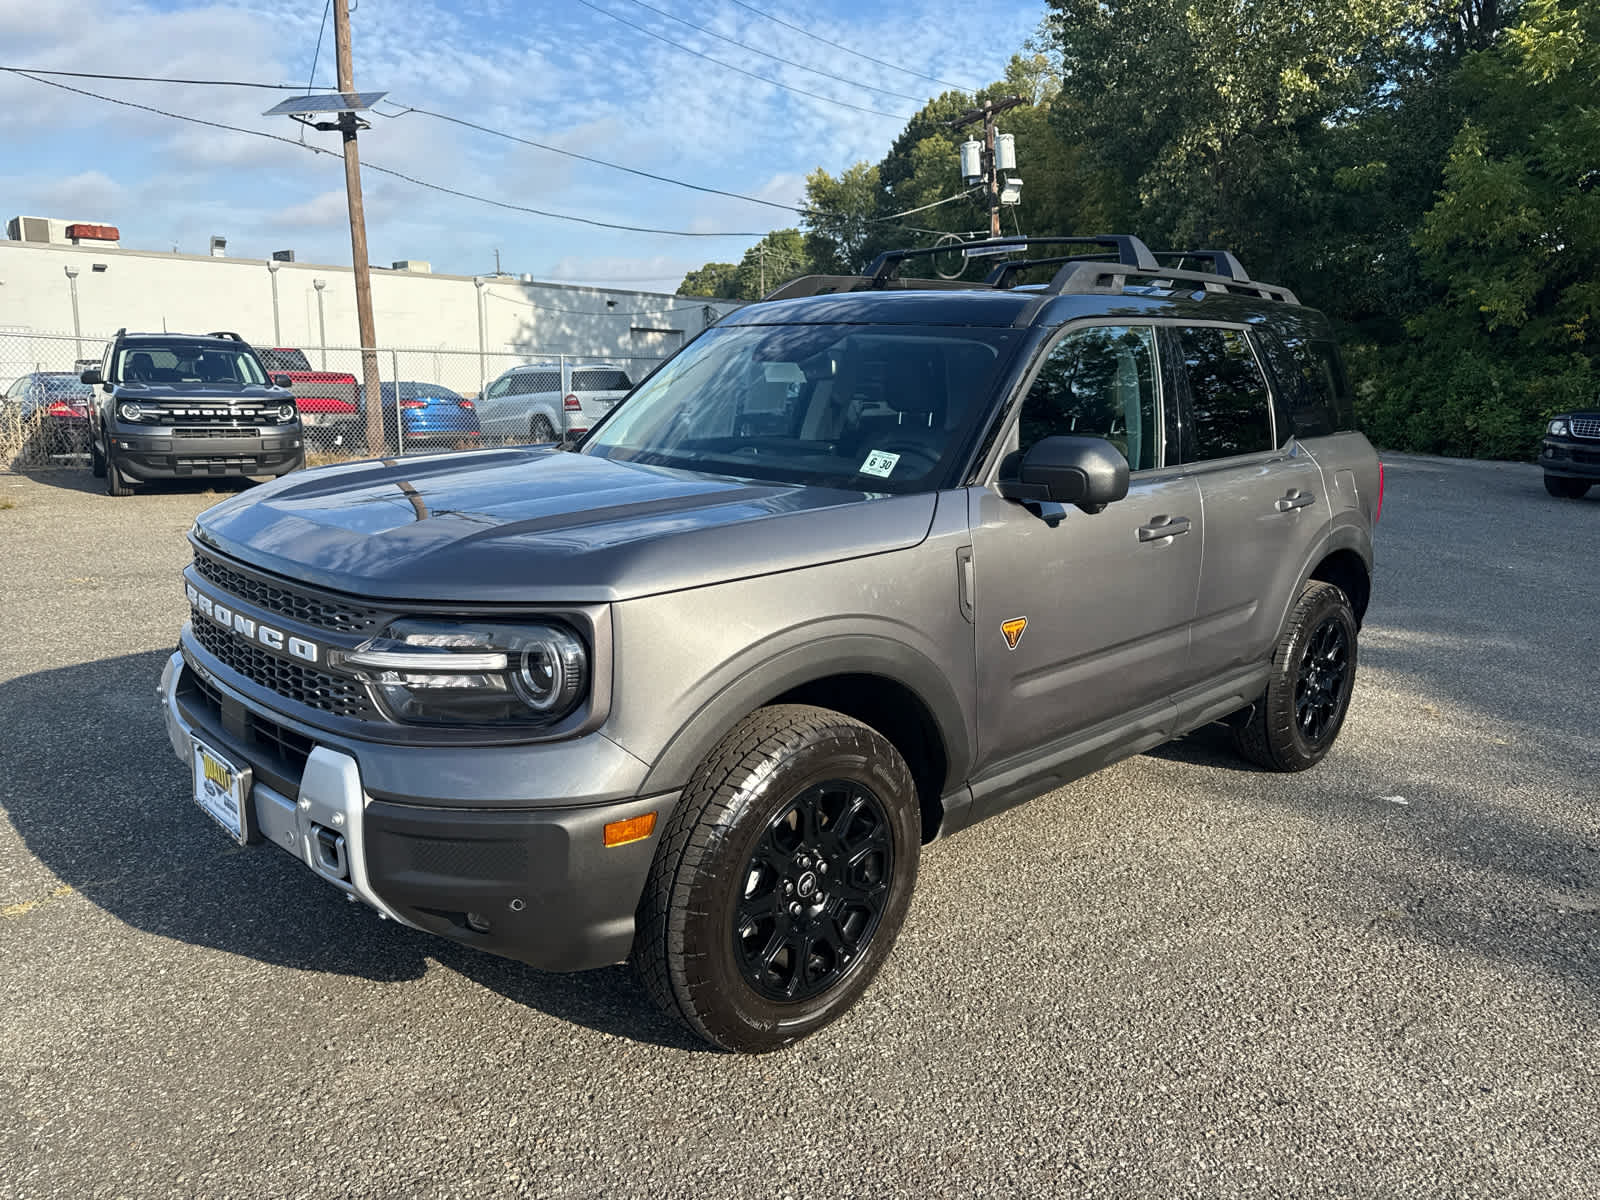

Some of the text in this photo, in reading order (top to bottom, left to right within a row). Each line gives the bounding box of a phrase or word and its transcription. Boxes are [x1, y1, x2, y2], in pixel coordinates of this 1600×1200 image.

[869, 458, 892, 470] 6 30
[187, 584, 318, 663] BRONCO
